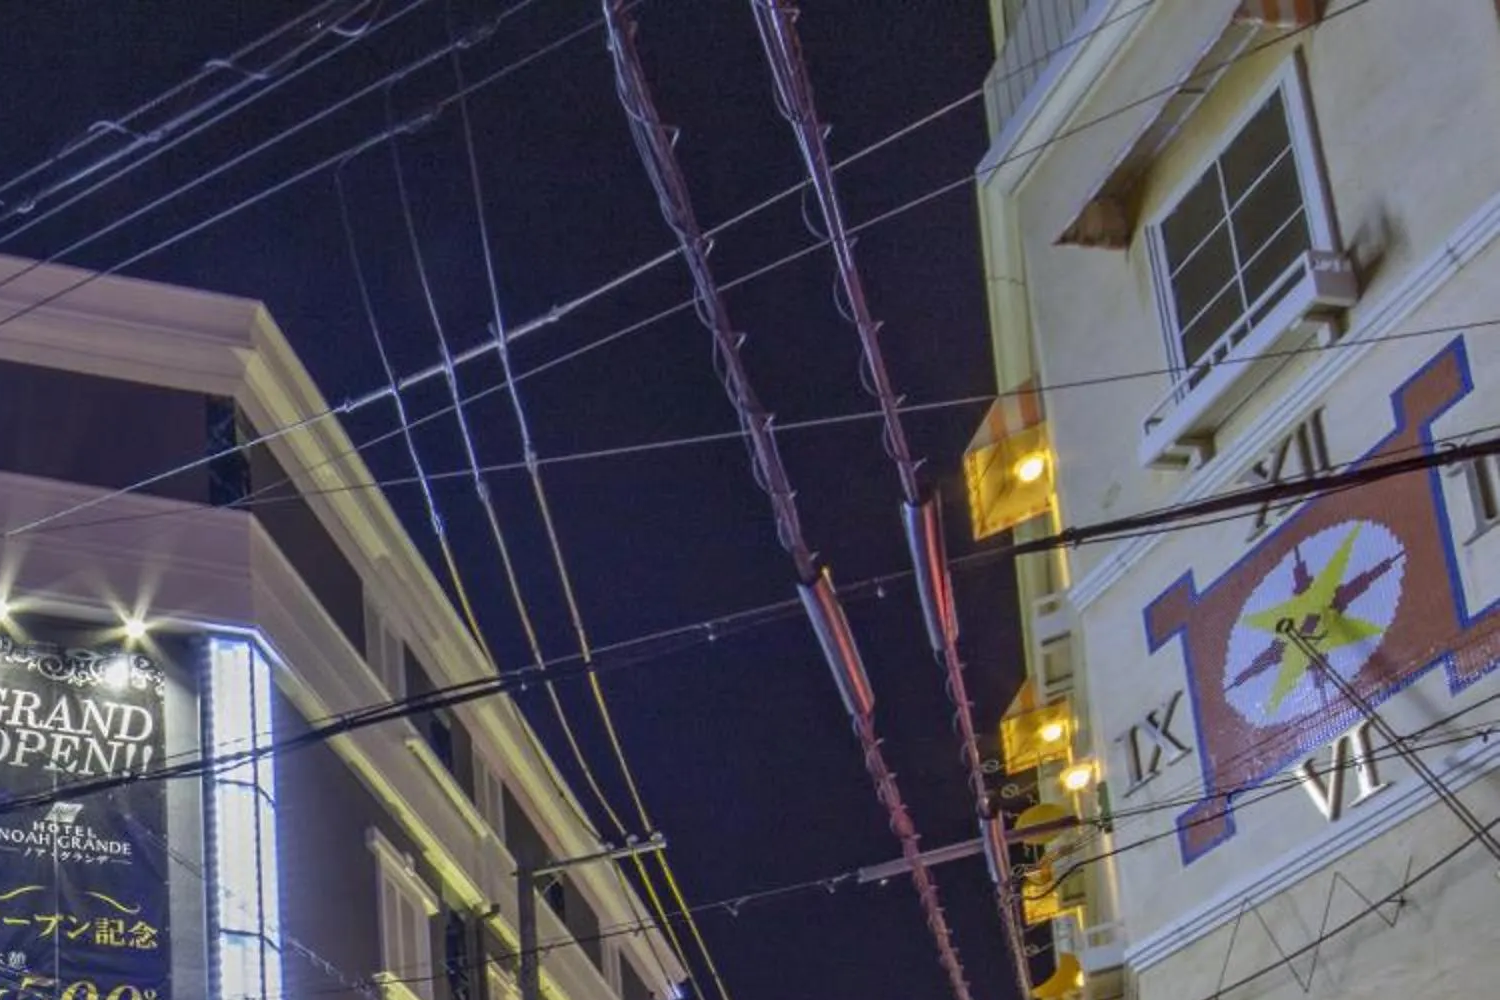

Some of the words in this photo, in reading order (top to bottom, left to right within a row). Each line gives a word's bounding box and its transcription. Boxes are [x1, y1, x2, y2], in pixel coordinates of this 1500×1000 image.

[1118, 690, 1192, 798] IX
[1297, 720, 1393, 822] VI
[32, 820, 98, 840] HOTEL
[57, 835, 133, 856] GRANDE
